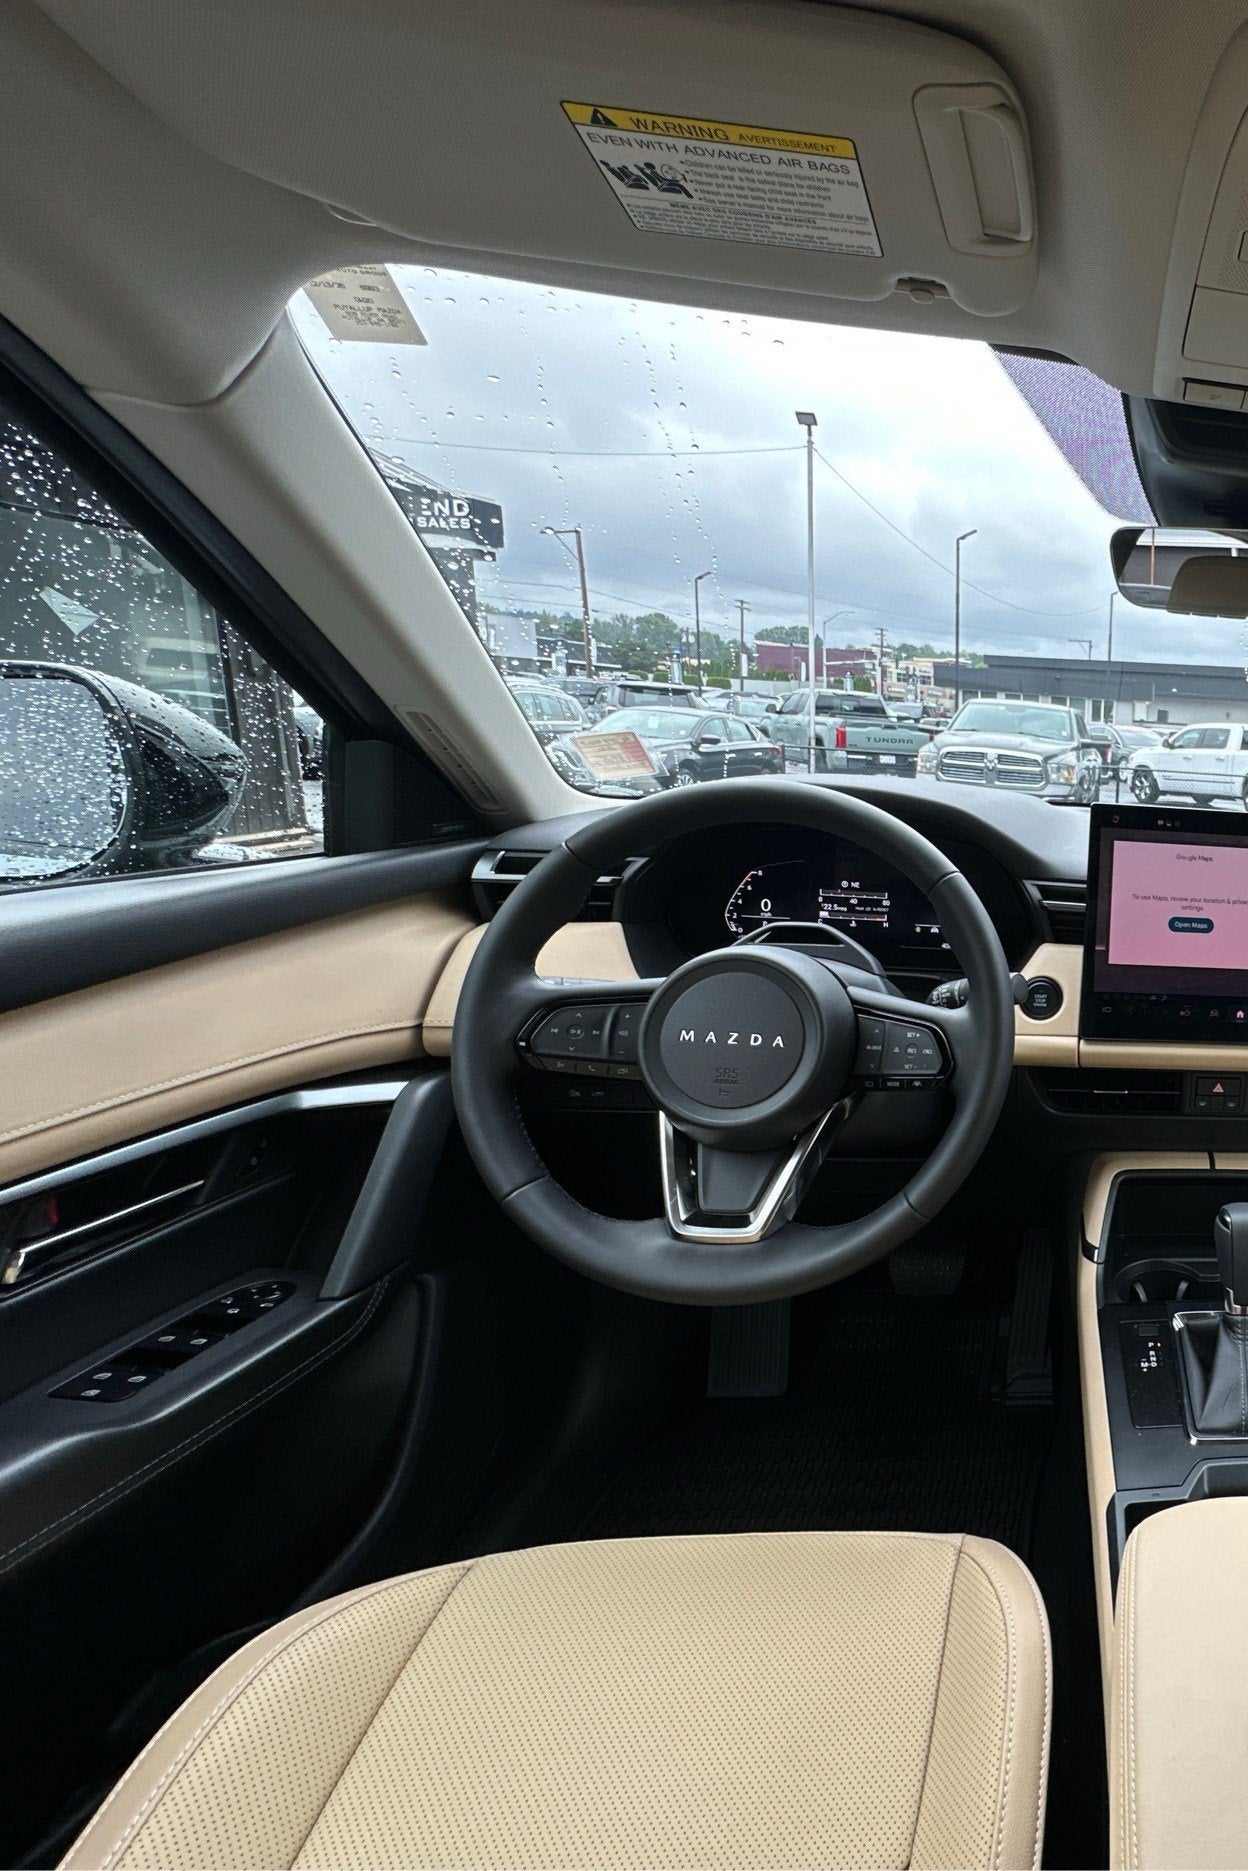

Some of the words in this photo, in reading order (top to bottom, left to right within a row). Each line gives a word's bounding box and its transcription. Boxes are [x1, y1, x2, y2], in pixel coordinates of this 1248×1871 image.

[629, 116, 729, 141] WARNING
[738, 133, 836, 153] AVERTISSEMENT
[587, 132, 633, 147] EVEN
[635, 138, 678, 153] WITH
[685, 145, 771, 165] ADVANCED
[777, 157, 803, 169] AIR
[807, 160, 850, 175] BAGS
[417, 516, 471, 530] SALES
[866, 736, 914, 745] TUNDRA
[1176, 853, 1197, 862] Google
[760, 898, 772, 912] 0
[1174, 921, 1191, 929] Open
[1191, 922, 1208, 930] Maps
[680, 1029, 785, 1049] MAZDA
[714, 1068, 740, 1079] SRS
